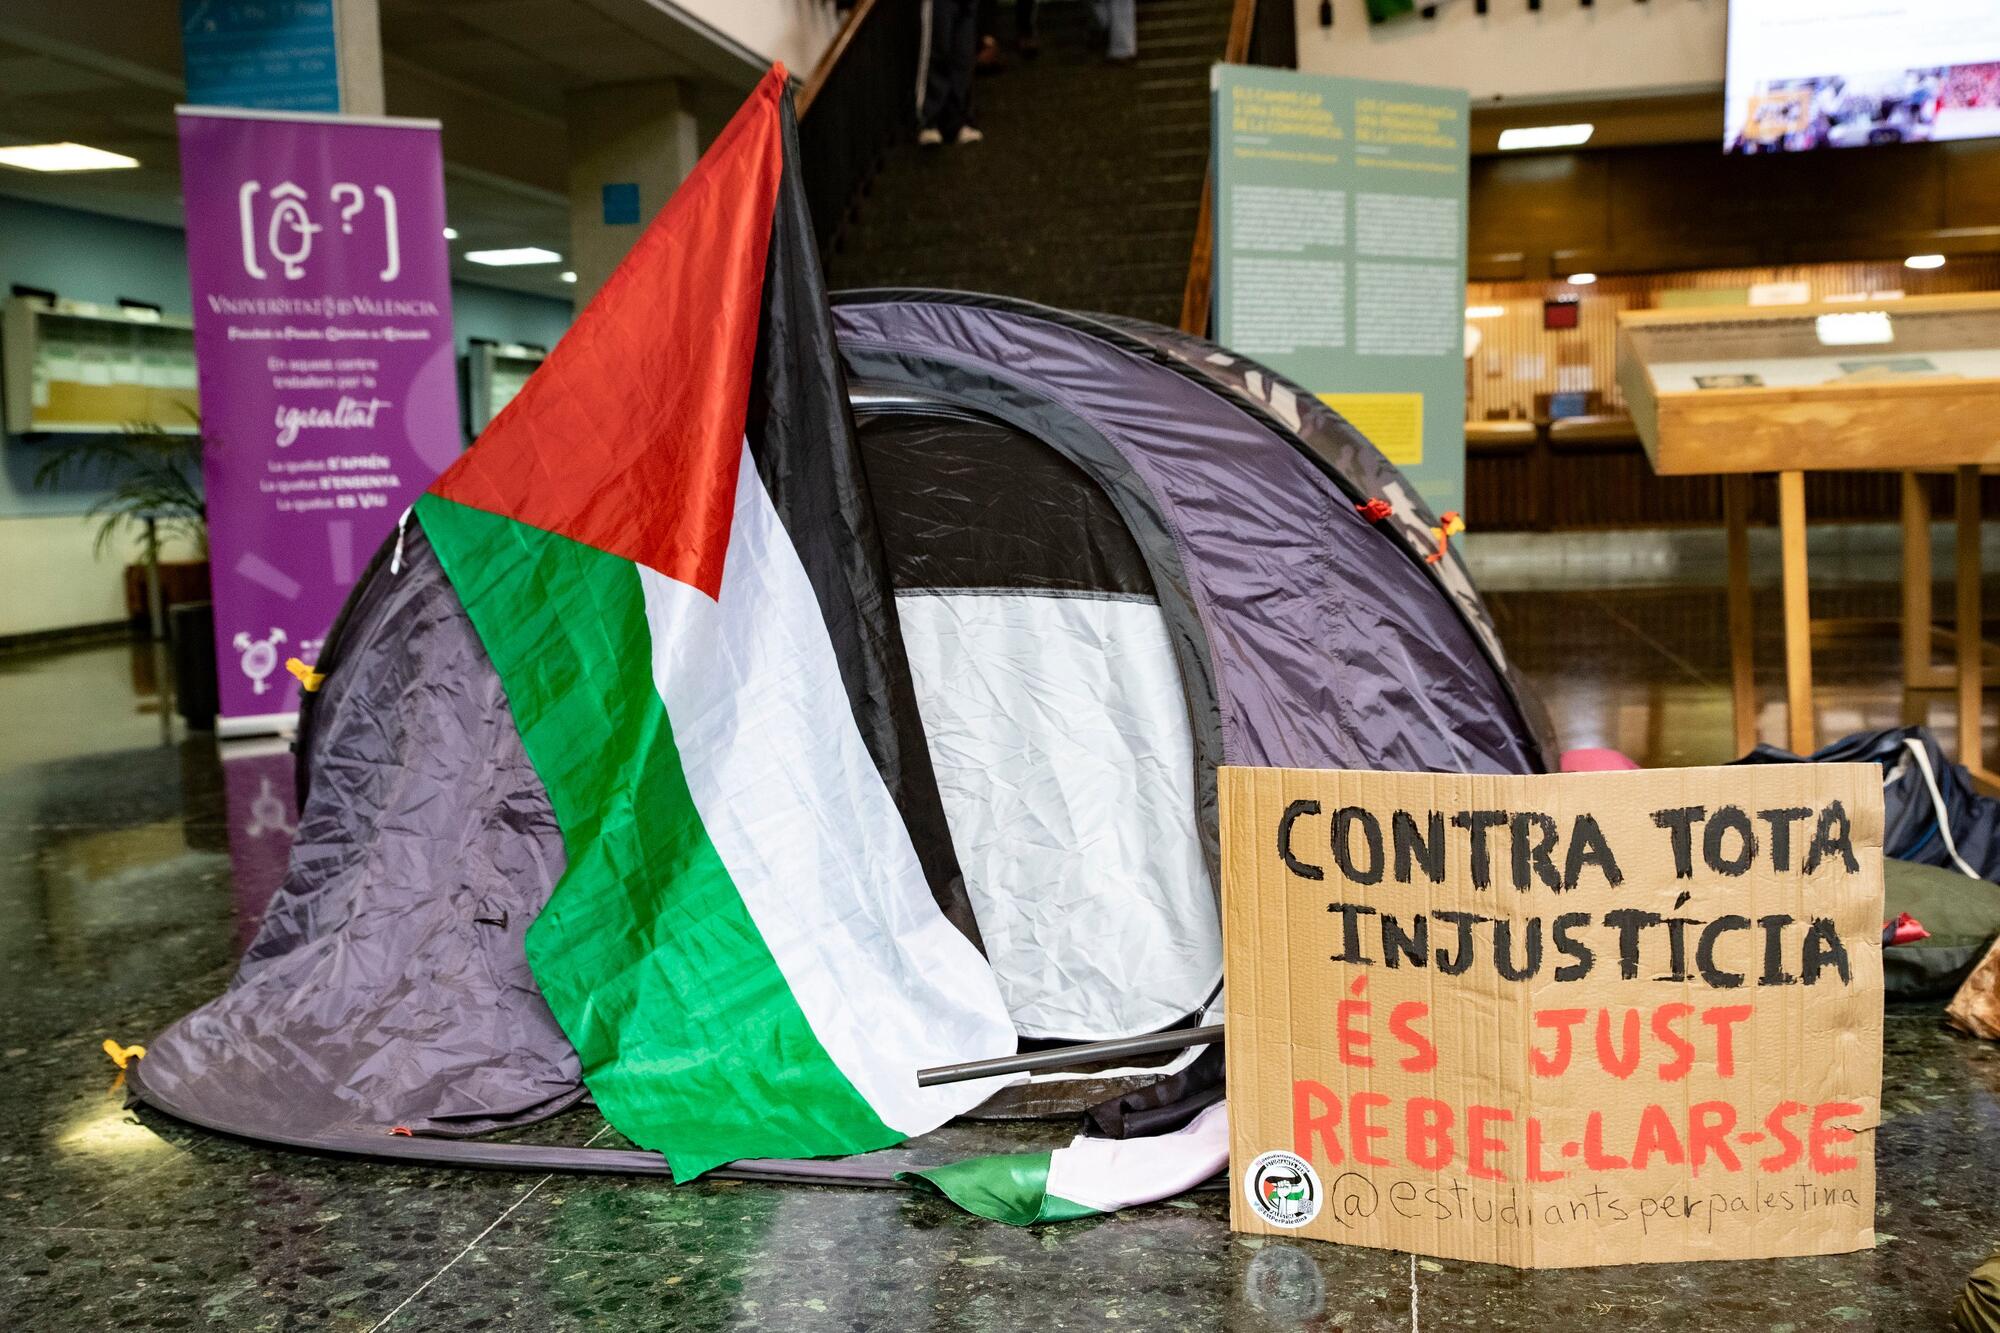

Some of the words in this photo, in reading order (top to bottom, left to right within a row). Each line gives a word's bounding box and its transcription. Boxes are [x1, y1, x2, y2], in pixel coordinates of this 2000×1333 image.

[275, 395, 393, 447] igualtat
[1277, 799, 1624, 894] CONTRA
[1649, 799, 1860, 879] TOTA
[1326, 891, 1852, 988] INJUSTÍCIA
[1336, 975, 1438, 1074] ÉS
[1529, 1002, 1755, 1081] JUST
[1332, 1172, 1860, 1235] @estudiantsperpalestina
